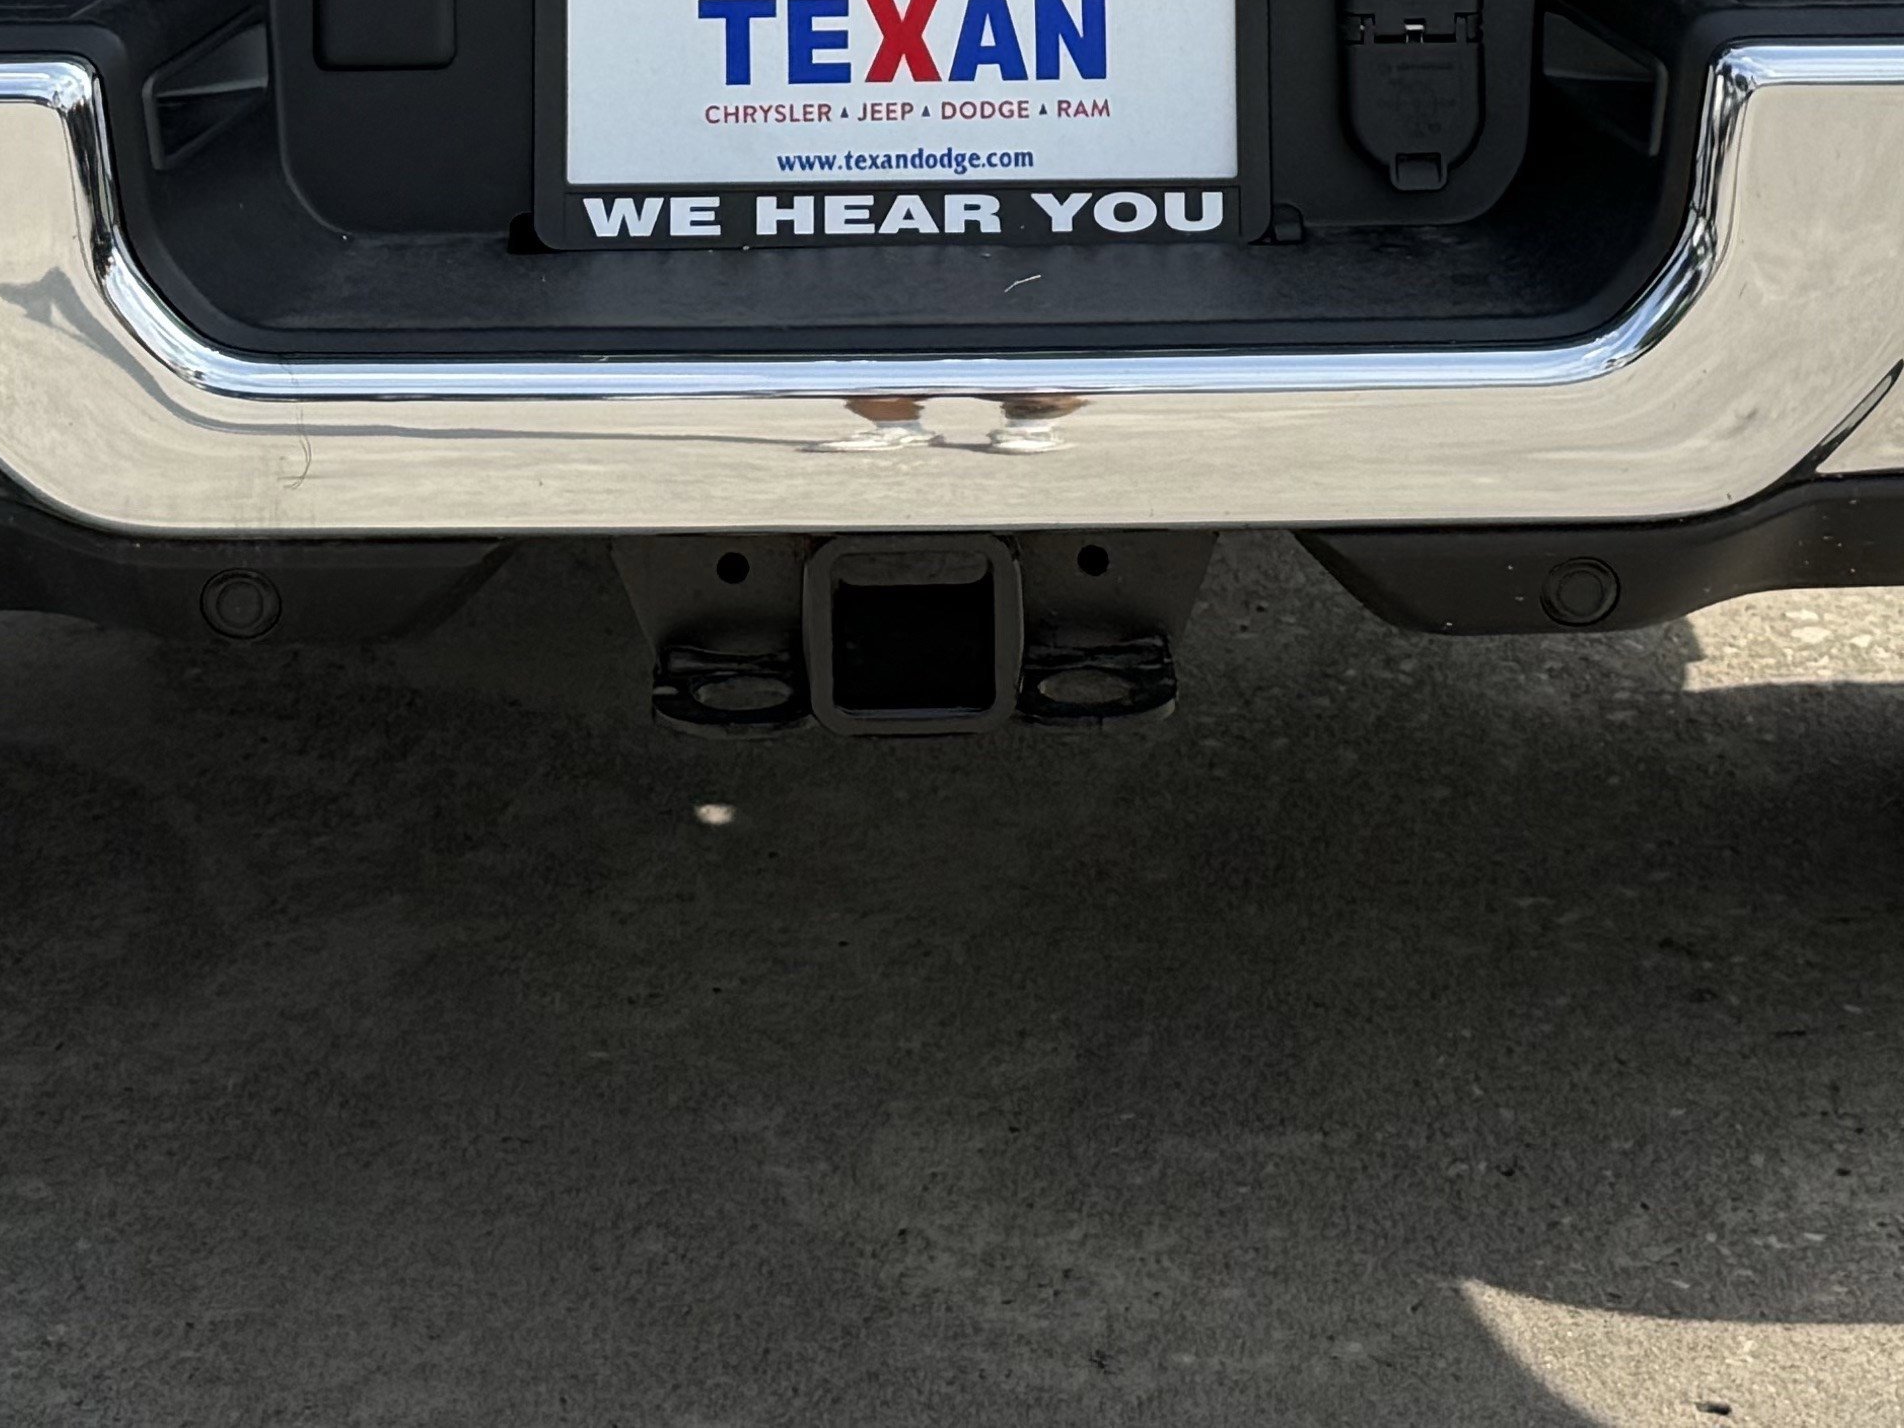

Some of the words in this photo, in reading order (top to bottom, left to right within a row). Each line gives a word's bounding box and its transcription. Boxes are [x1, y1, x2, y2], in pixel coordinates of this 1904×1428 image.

[704, 104, 833, 125] CHRYSLER
[857, 101, 915, 123] JEEP
[940, 100, 1032, 121] DODGE
[1056, 99, 1112, 119] RAM
[776, 147, 1035, 175] www.texandodge.com
[583, 196, 722, 238] WE
[755, 194, 1002, 235] HEAR
[1030, 191, 1226, 234] YOU
